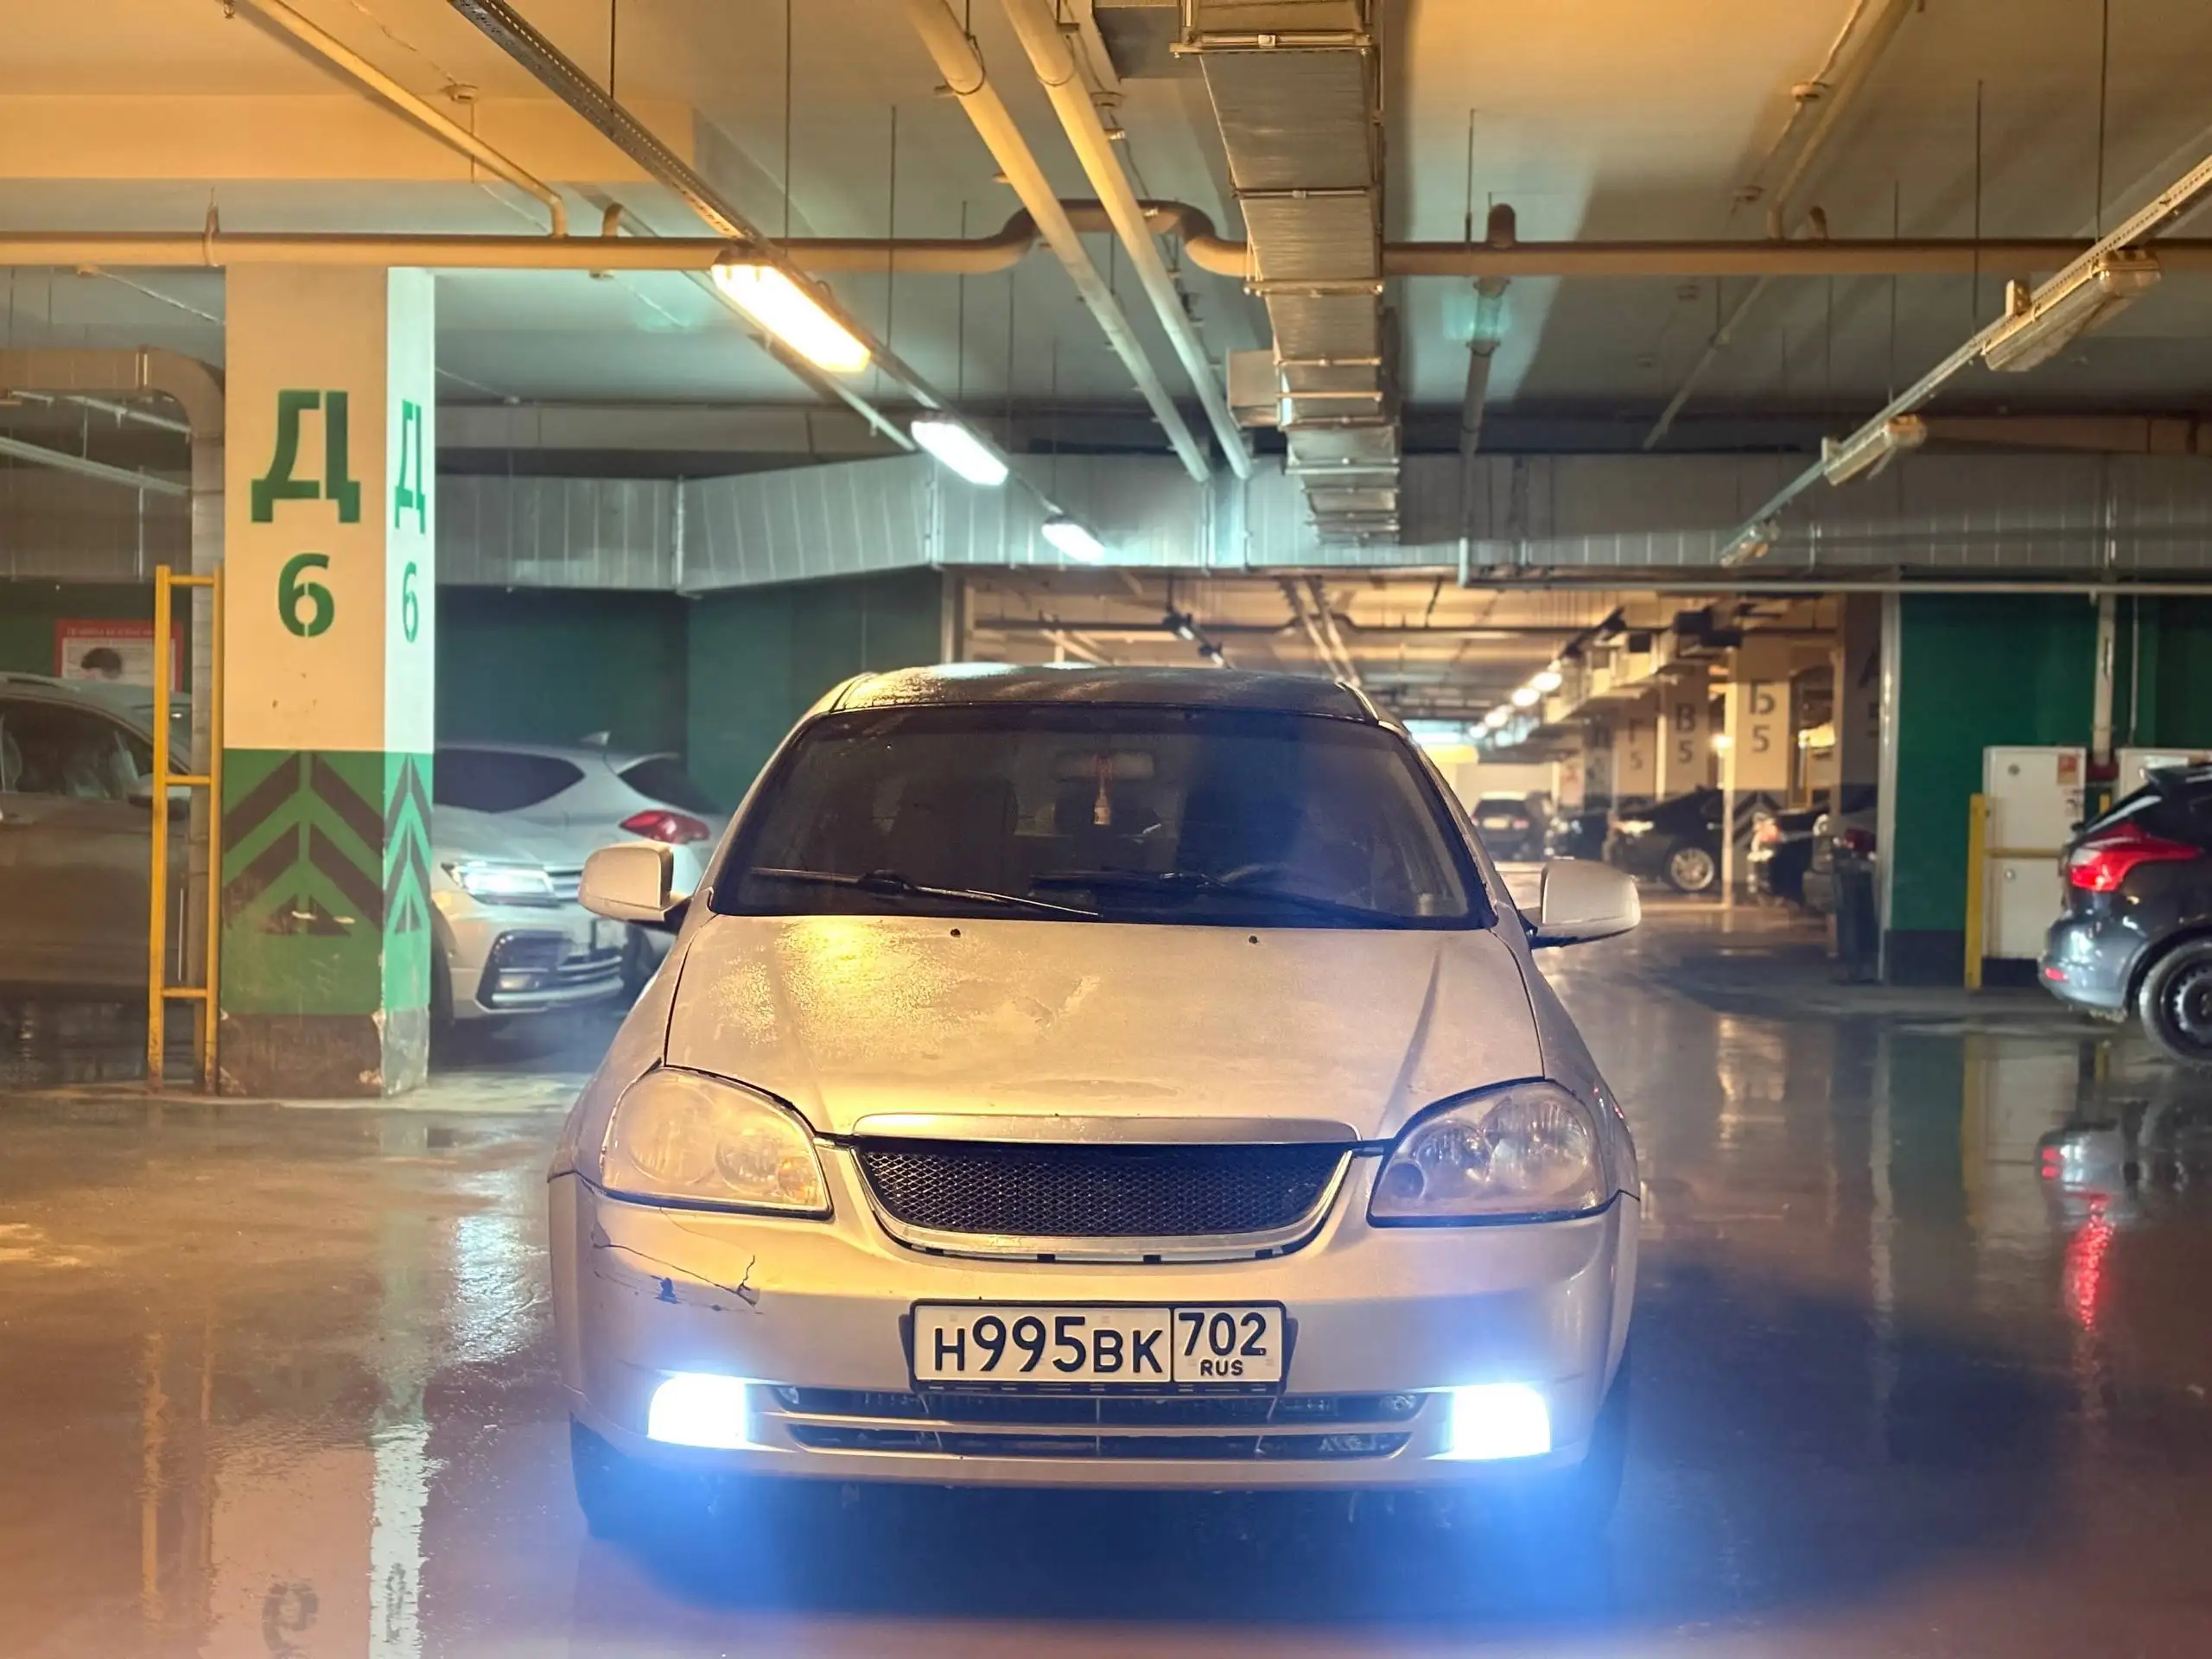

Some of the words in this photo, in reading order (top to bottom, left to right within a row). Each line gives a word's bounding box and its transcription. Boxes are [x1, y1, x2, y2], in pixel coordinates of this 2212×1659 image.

[251, 390, 360, 524] Д
[395, 399, 426, 534] Д
[277, 553, 334, 638] 6
[403, 561, 419, 643] 6
[1678, 740, 1694, 765] 5
[1751, 725, 1770, 752] 5
[1178, 1312, 1267, 1357] 702
[1199, 1358, 1243, 1376] RUS
